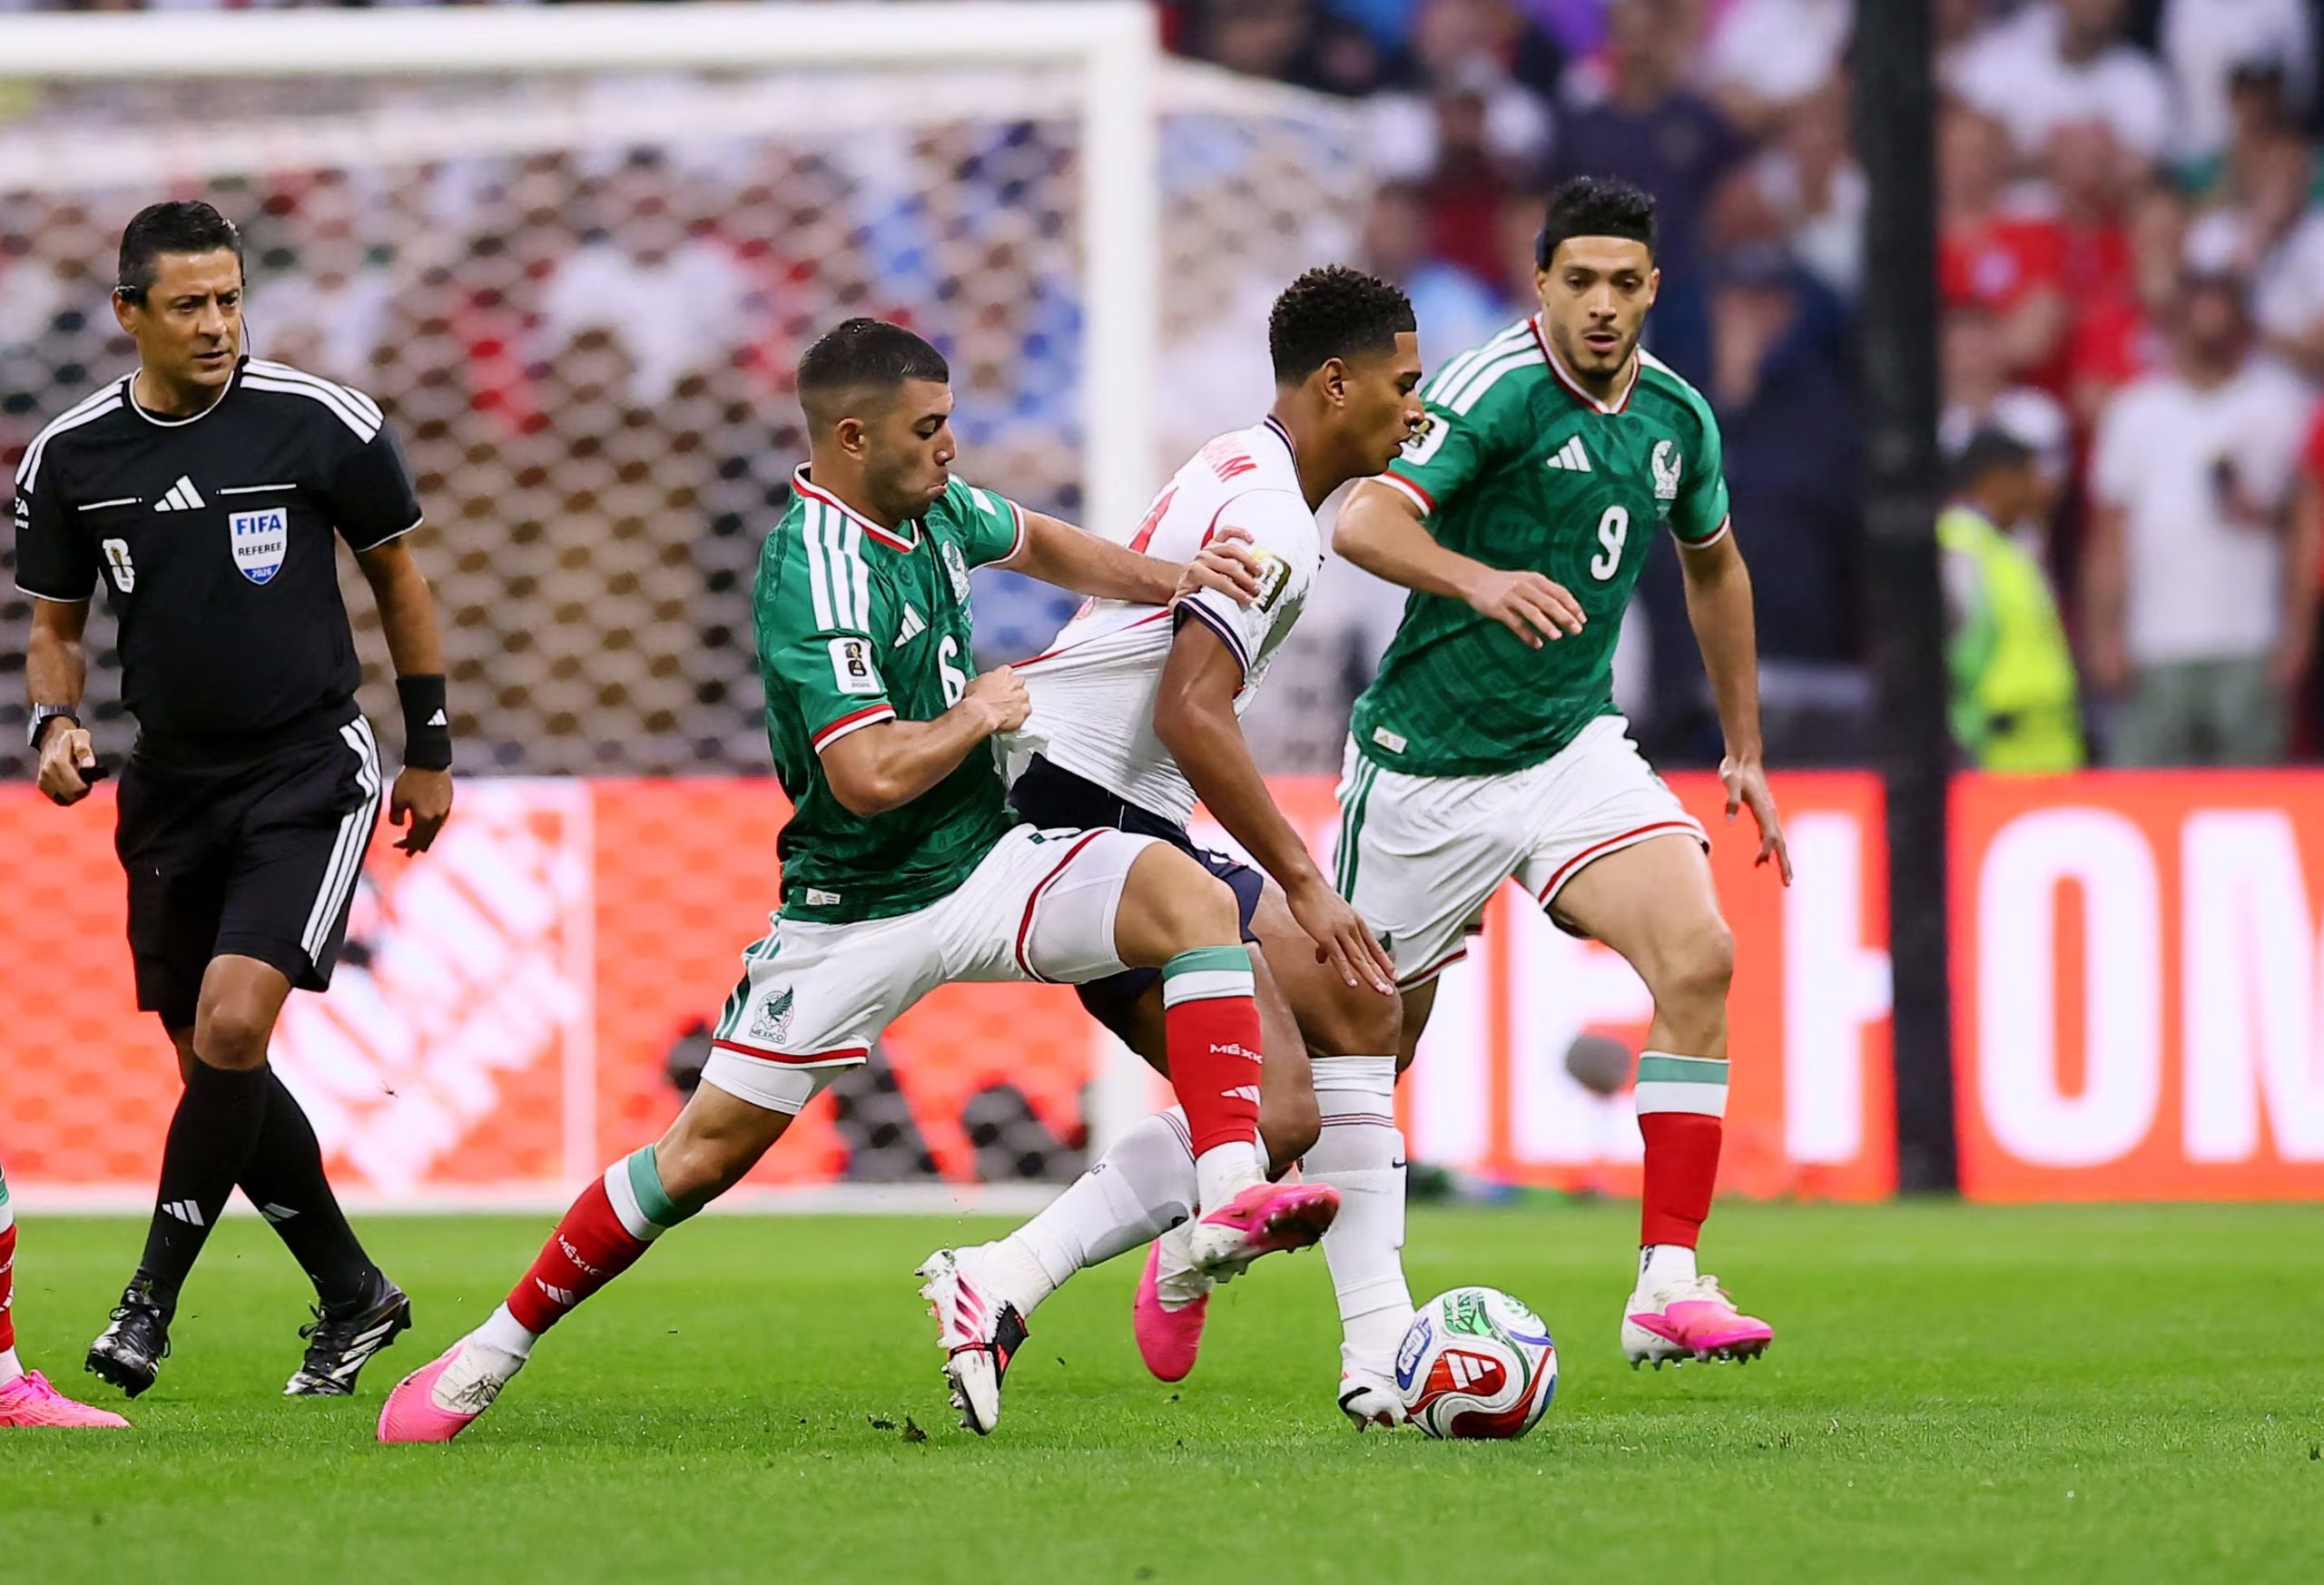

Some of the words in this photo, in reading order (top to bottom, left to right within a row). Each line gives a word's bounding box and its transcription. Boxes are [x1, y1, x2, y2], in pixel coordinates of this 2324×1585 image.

[236, 514, 282, 535] FIFA
[238, 542, 282, 556] REFEREE
[1590, 506, 1630, 581] 9
[938, 635, 967, 709] 6
[751, 1028, 784, 1041] MEXICO
[1209, 1042, 1263, 1065] MÉXIC
